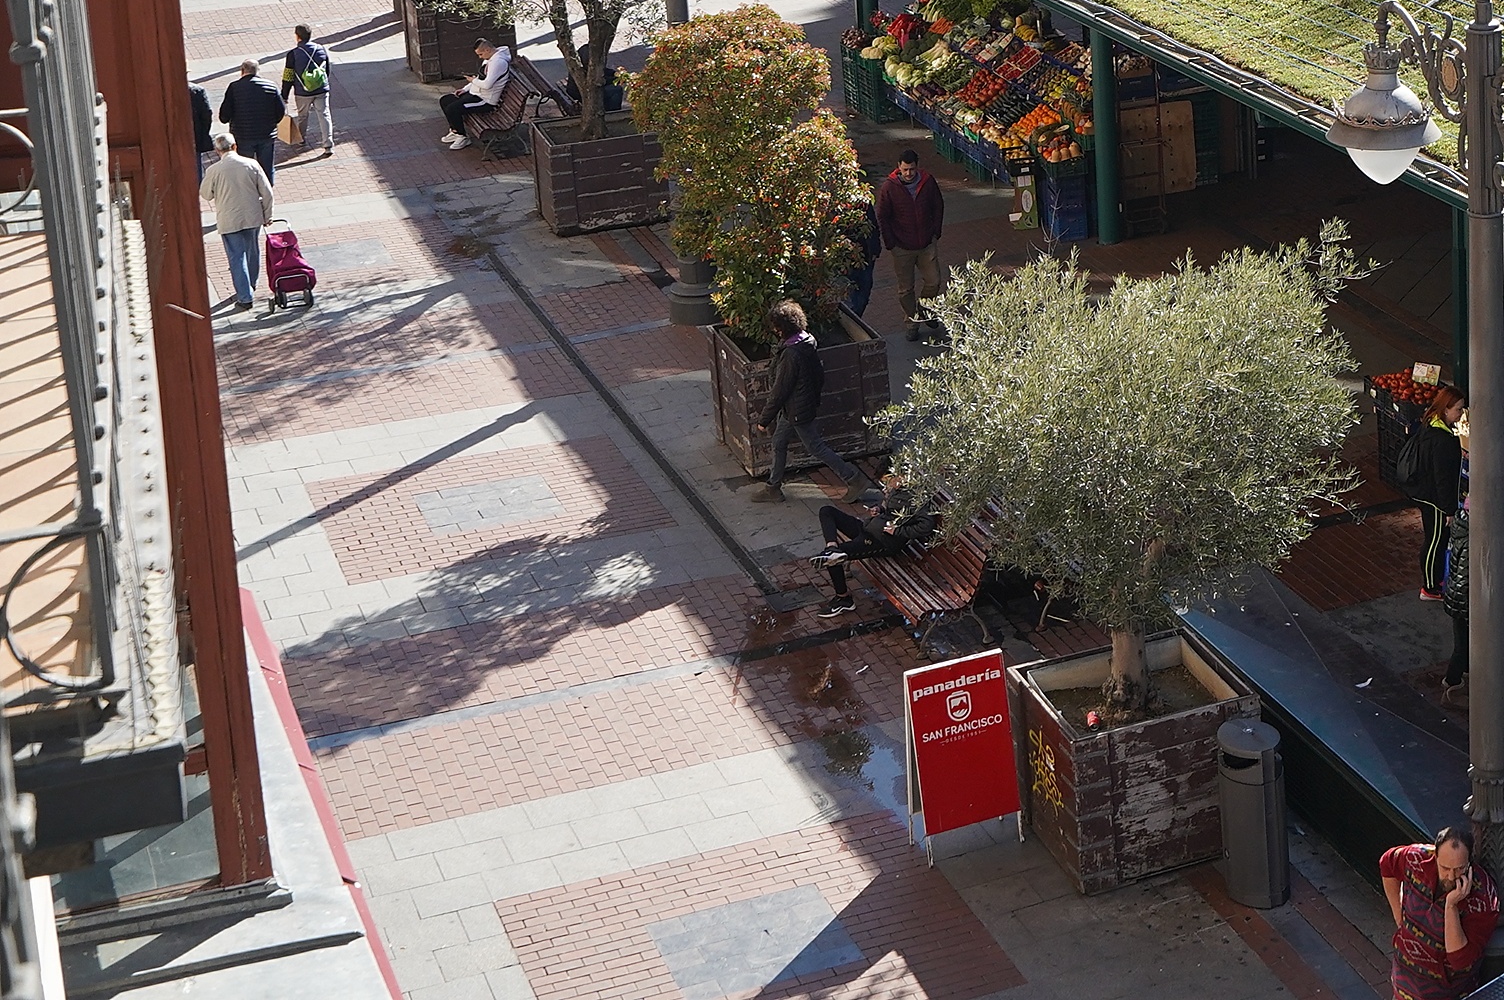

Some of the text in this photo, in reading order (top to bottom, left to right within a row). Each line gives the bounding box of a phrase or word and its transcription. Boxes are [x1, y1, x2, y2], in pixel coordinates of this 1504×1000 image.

[912, 668, 1002, 702] panadería
[922, 714, 1002, 743] SAN FRANCISCO
[946, 734, 966, 743] DESDE
